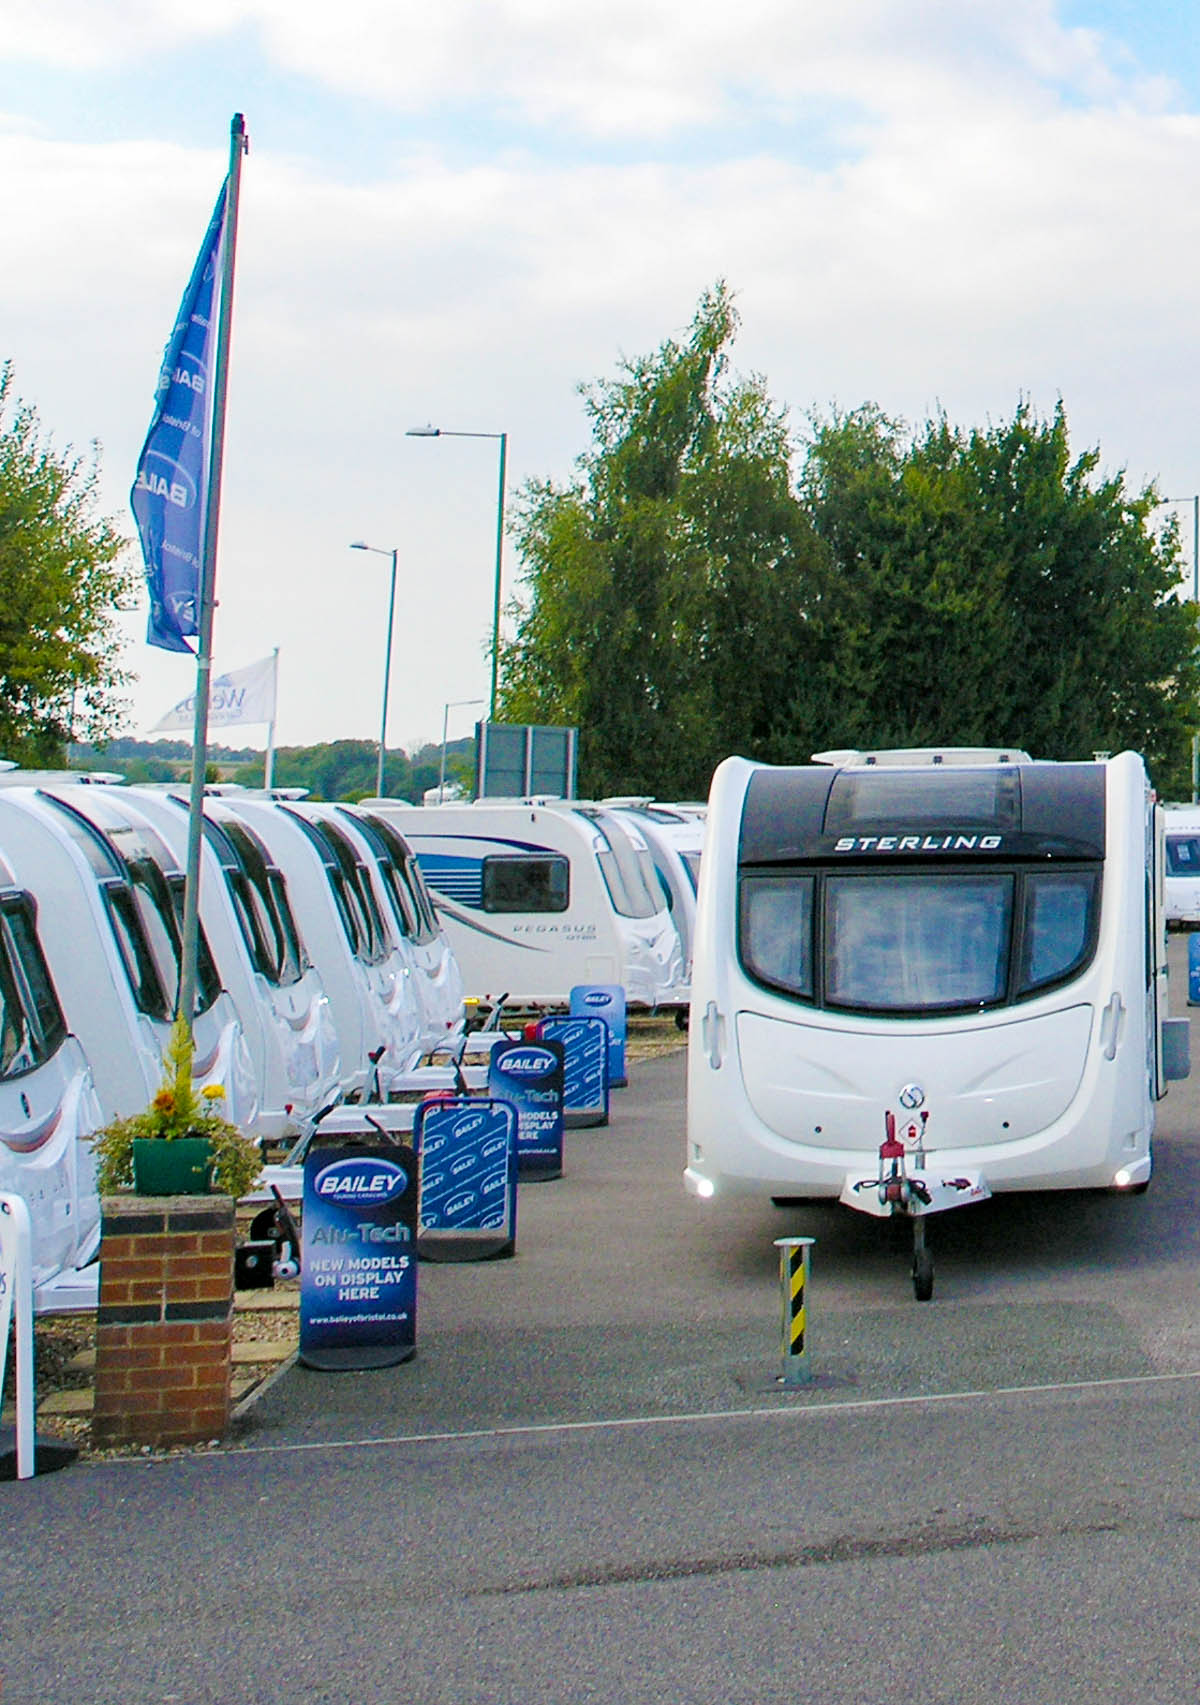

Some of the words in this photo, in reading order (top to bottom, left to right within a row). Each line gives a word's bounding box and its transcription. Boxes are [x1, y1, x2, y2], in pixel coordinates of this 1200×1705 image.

[834, 835, 1002, 851] STERLING
[501, 1057, 553, 1071] BAILEY
[320, 1174, 402, 1194] BAILEY
[312, 1221, 410, 1245] Alu-Tech
[310, 1259, 344, 1271] NEW
[348, 1256, 409, 1269] MODELS
[315, 1274, 336, 1287] ON
[341, 1271, 403, 1285] DISPLAY
[339, 1287, 380, 1300] HERE
